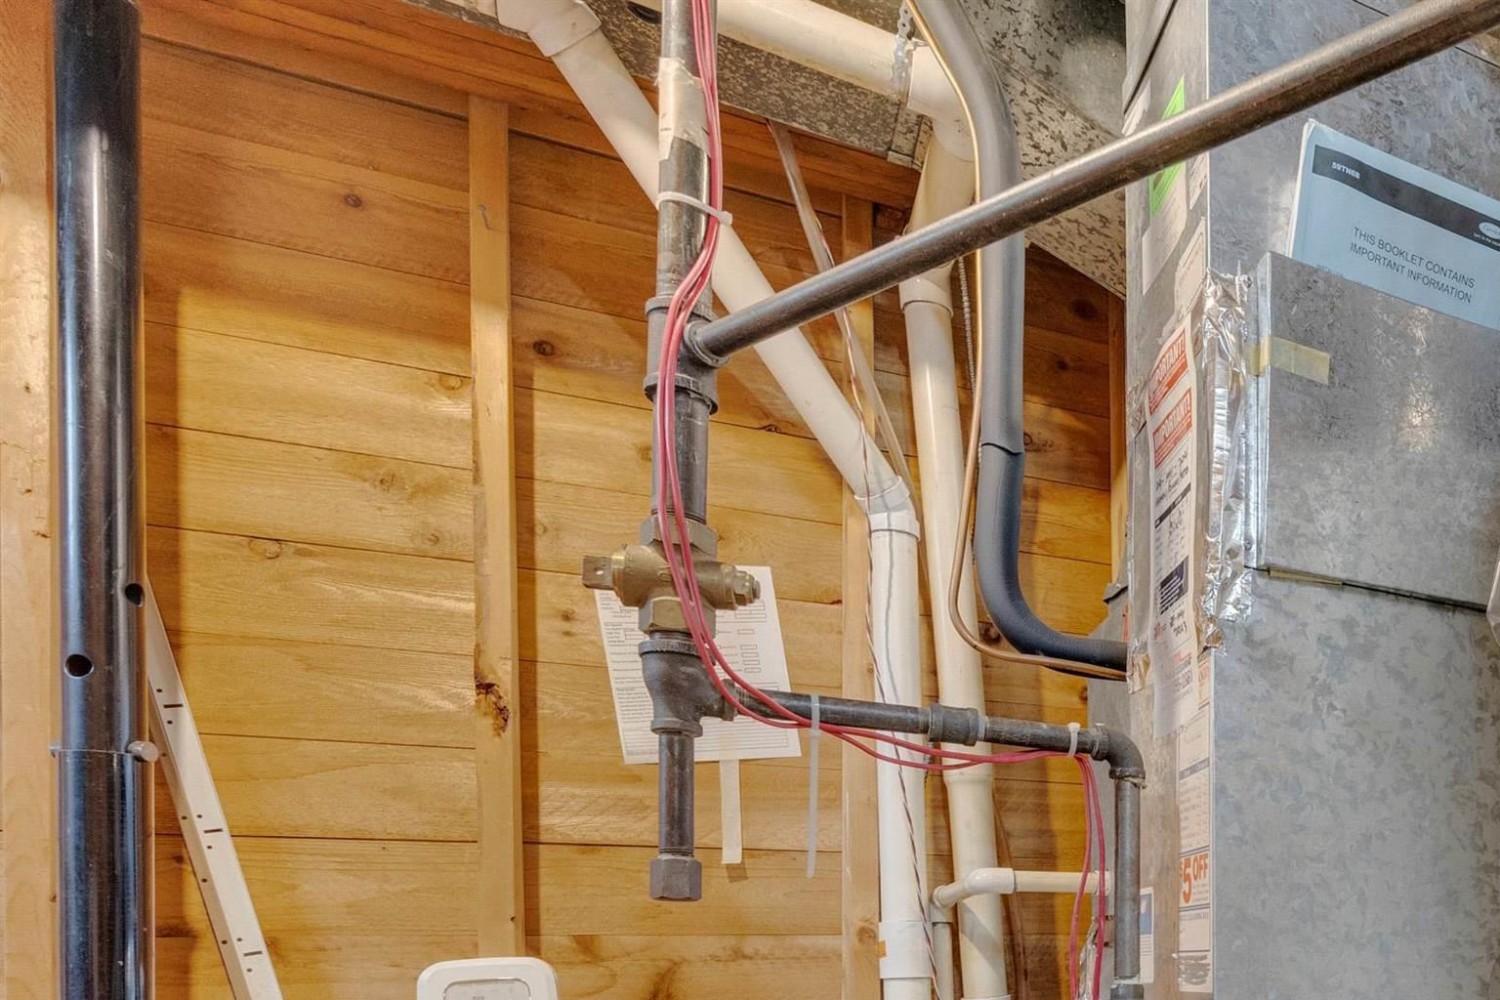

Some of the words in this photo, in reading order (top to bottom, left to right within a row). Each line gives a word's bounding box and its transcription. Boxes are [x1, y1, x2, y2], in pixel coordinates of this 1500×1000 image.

[1350, 243, 1405, 274] IMPORTANT
[1407, 268, 1472, 303] INFORMATION
[1353, 227, 1376, 246] THIS
[1377, 238, 1423, 267] BOOKLET
[1425, 260, 1476, 289] CONTAINS
[1192, 853, 1209, 881] OFF
